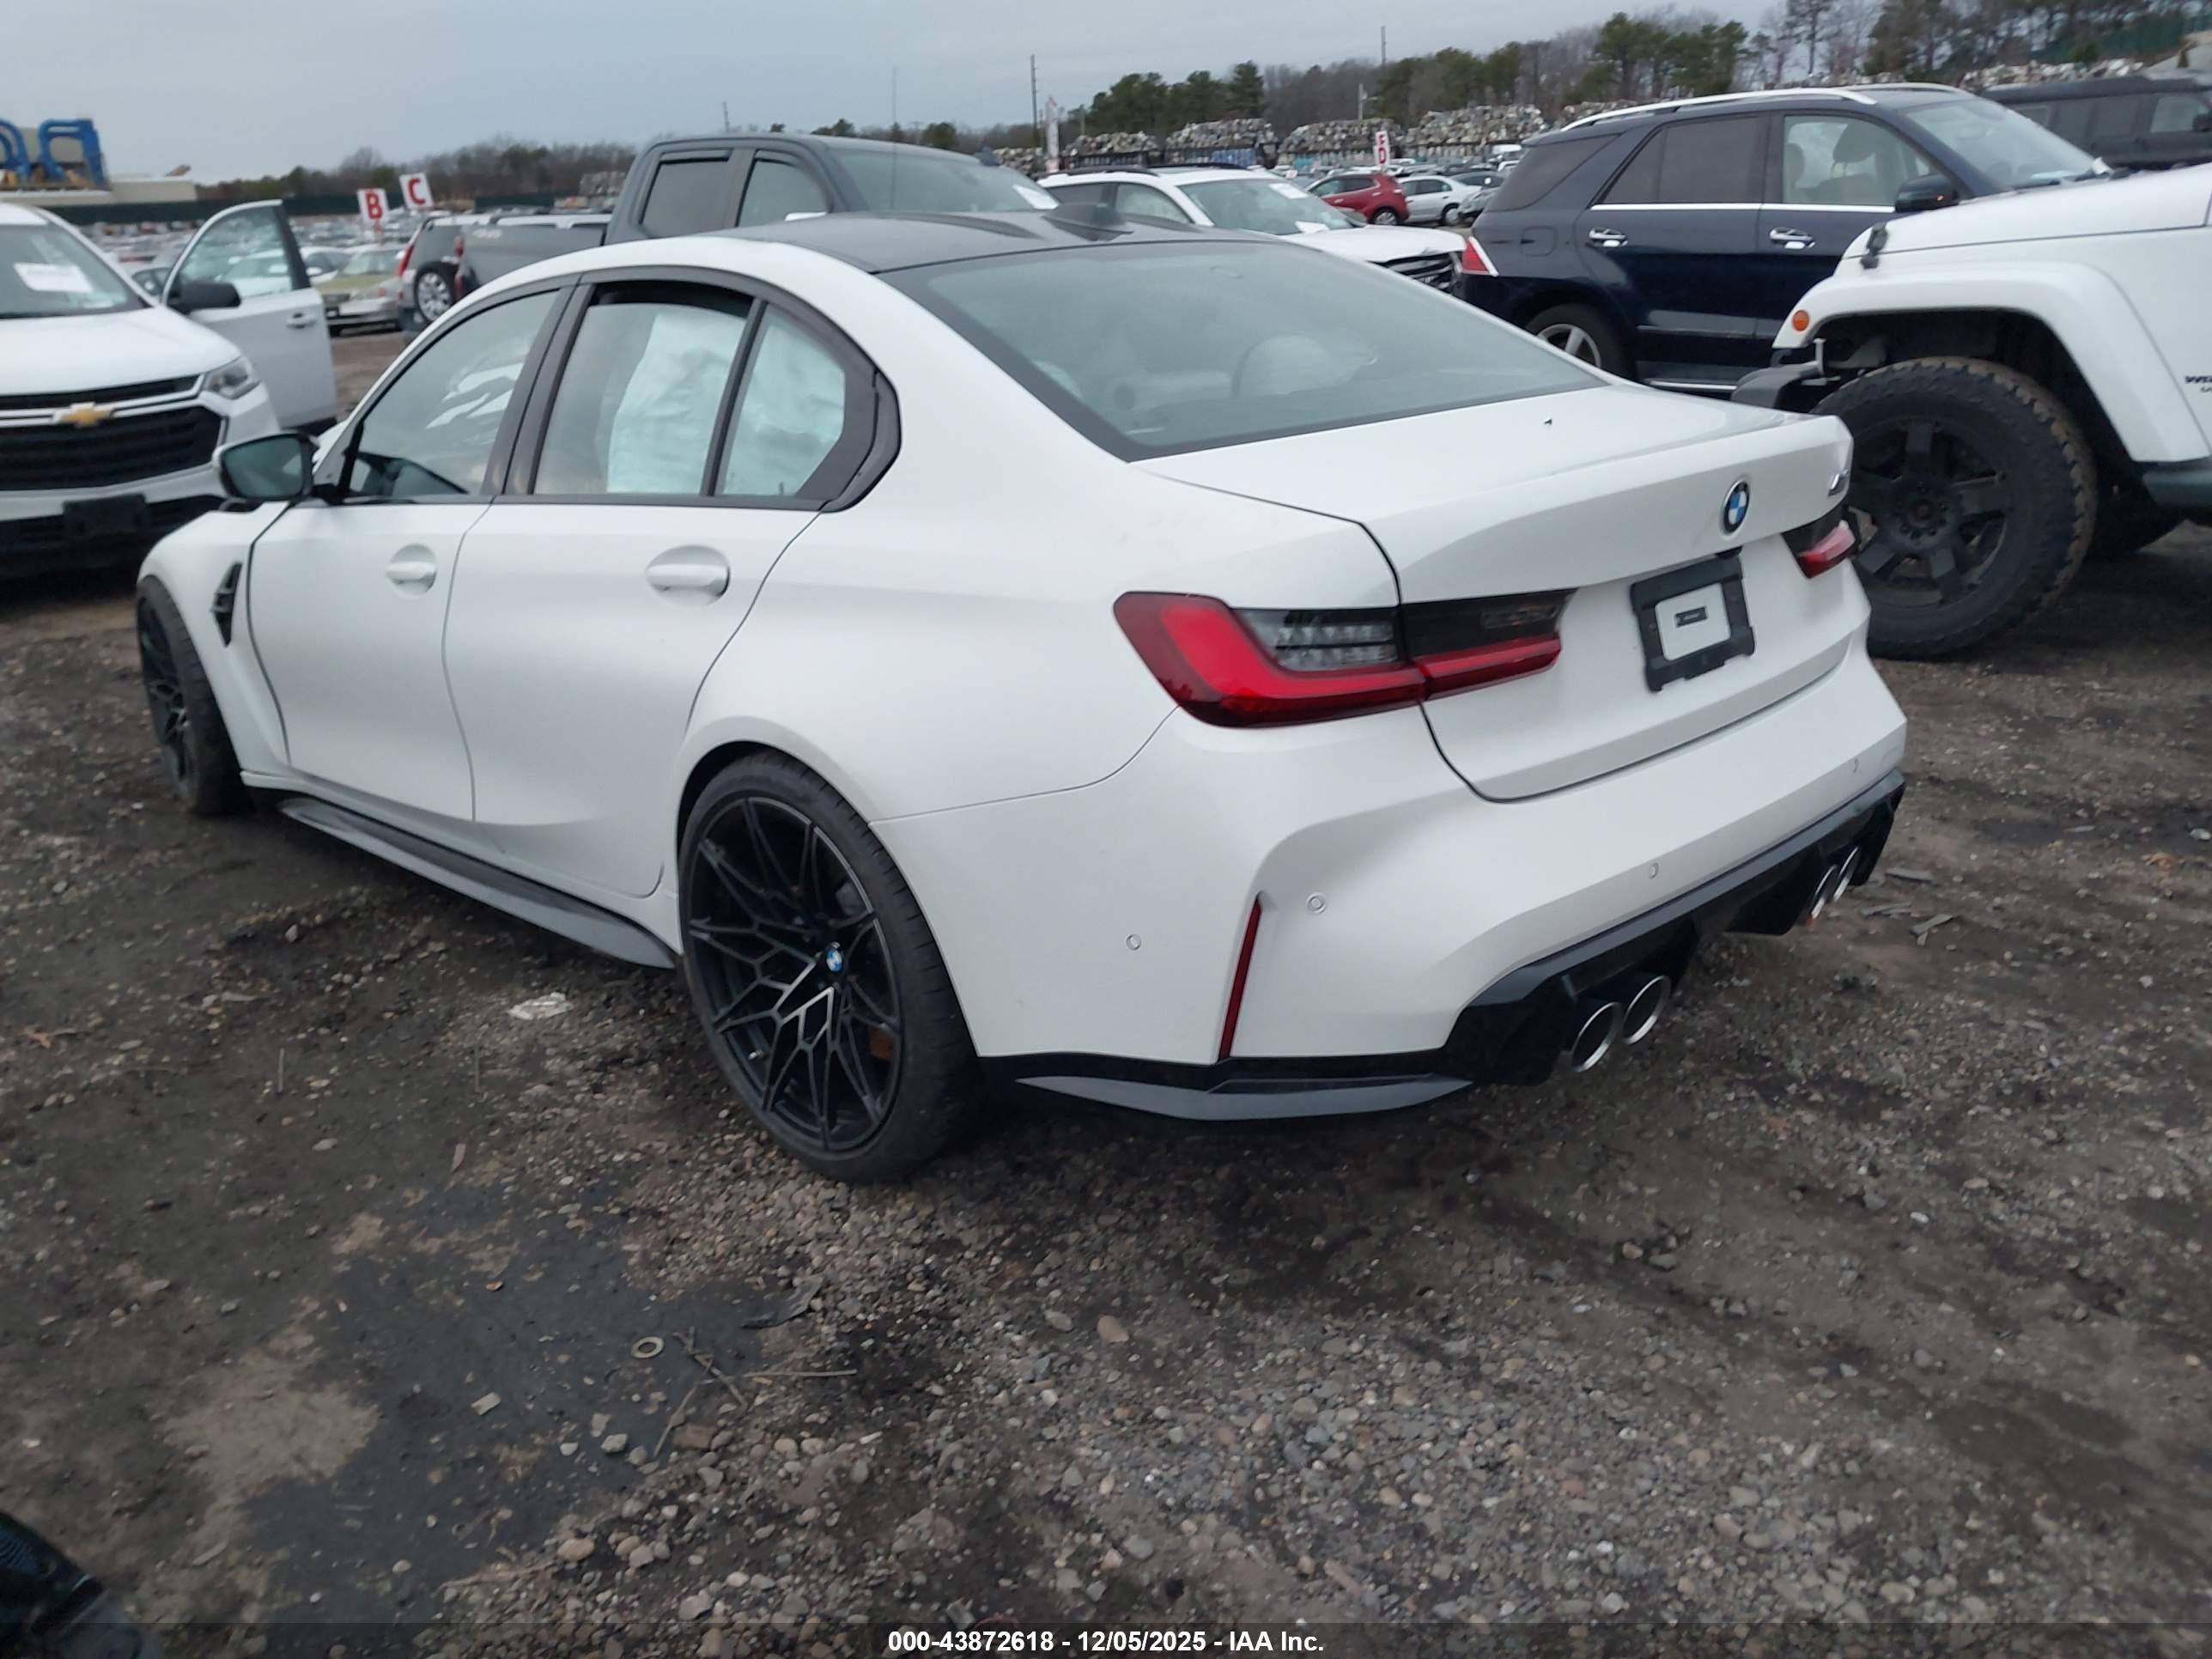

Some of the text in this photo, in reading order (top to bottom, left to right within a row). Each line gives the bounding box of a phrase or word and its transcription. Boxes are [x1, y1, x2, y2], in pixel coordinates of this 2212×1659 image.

[1378, 147, 1387, 164] D
[408, 178, 426, 205] C
[365, 191, 383, 220] B
